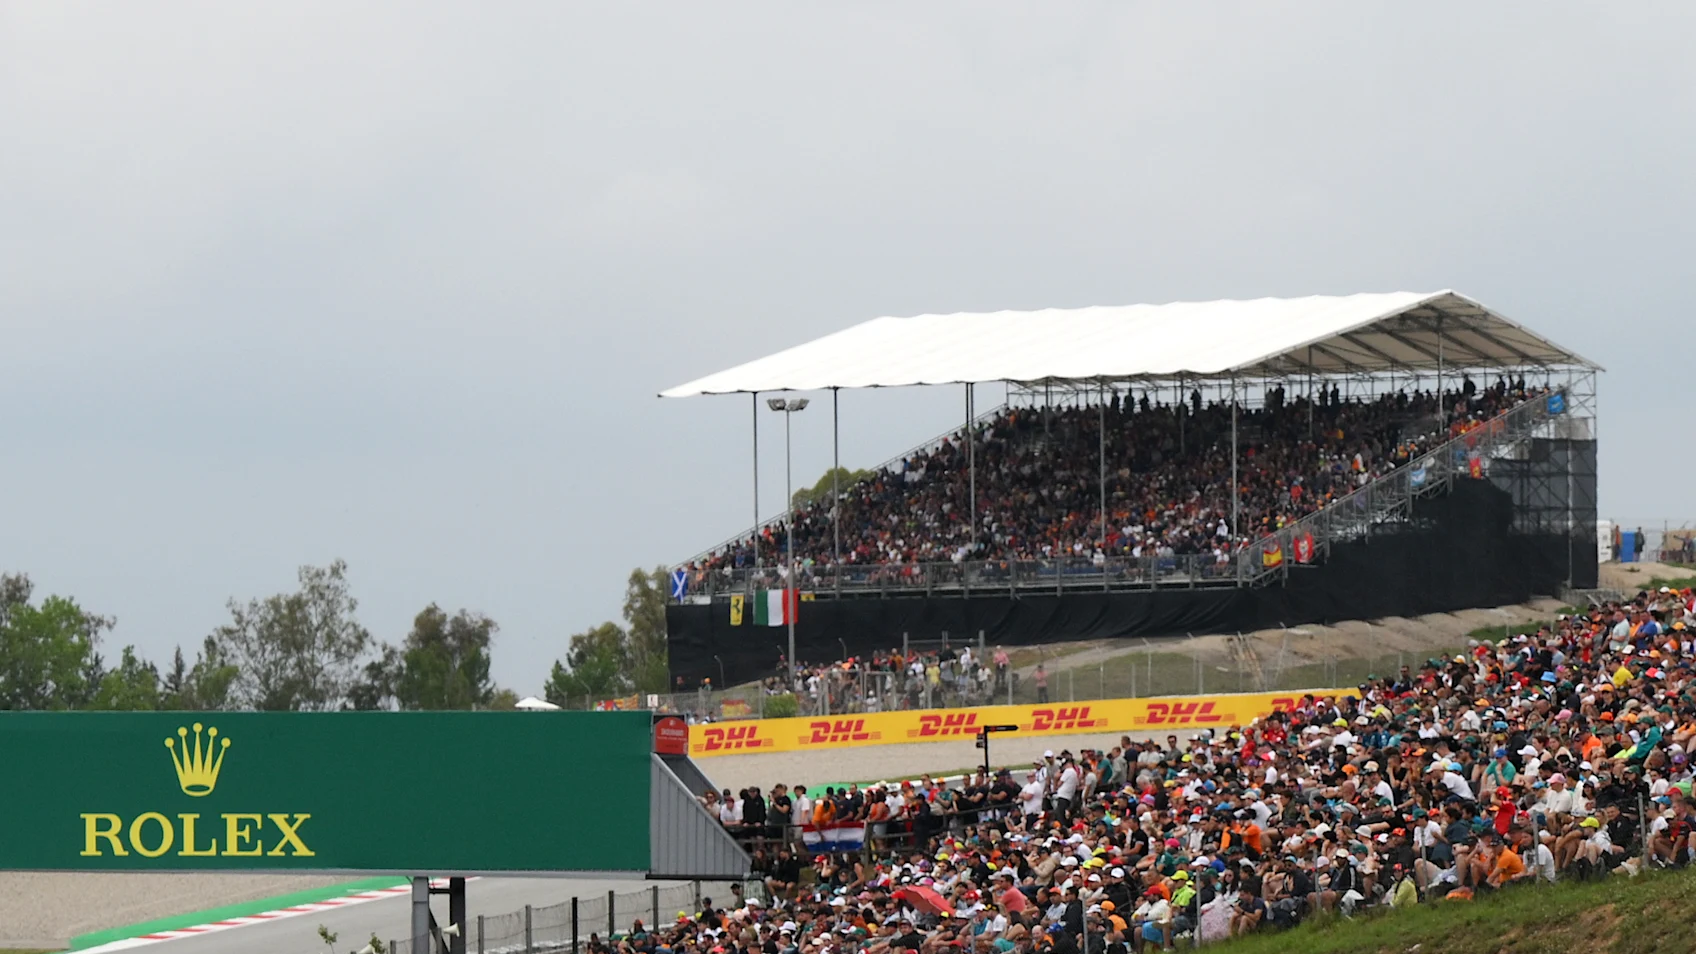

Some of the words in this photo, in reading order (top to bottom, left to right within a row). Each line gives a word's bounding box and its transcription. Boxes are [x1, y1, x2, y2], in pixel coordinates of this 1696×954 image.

[918, 713, 983, 737] DHL
[1030, 706, 1096, 731] DHL
[1145, 701, 1223, 724] DHL
[703, 725, 763, 751] DHL
[809, 719, 870, 744] DHL
[80, 812, 315, 857] ROLEX
